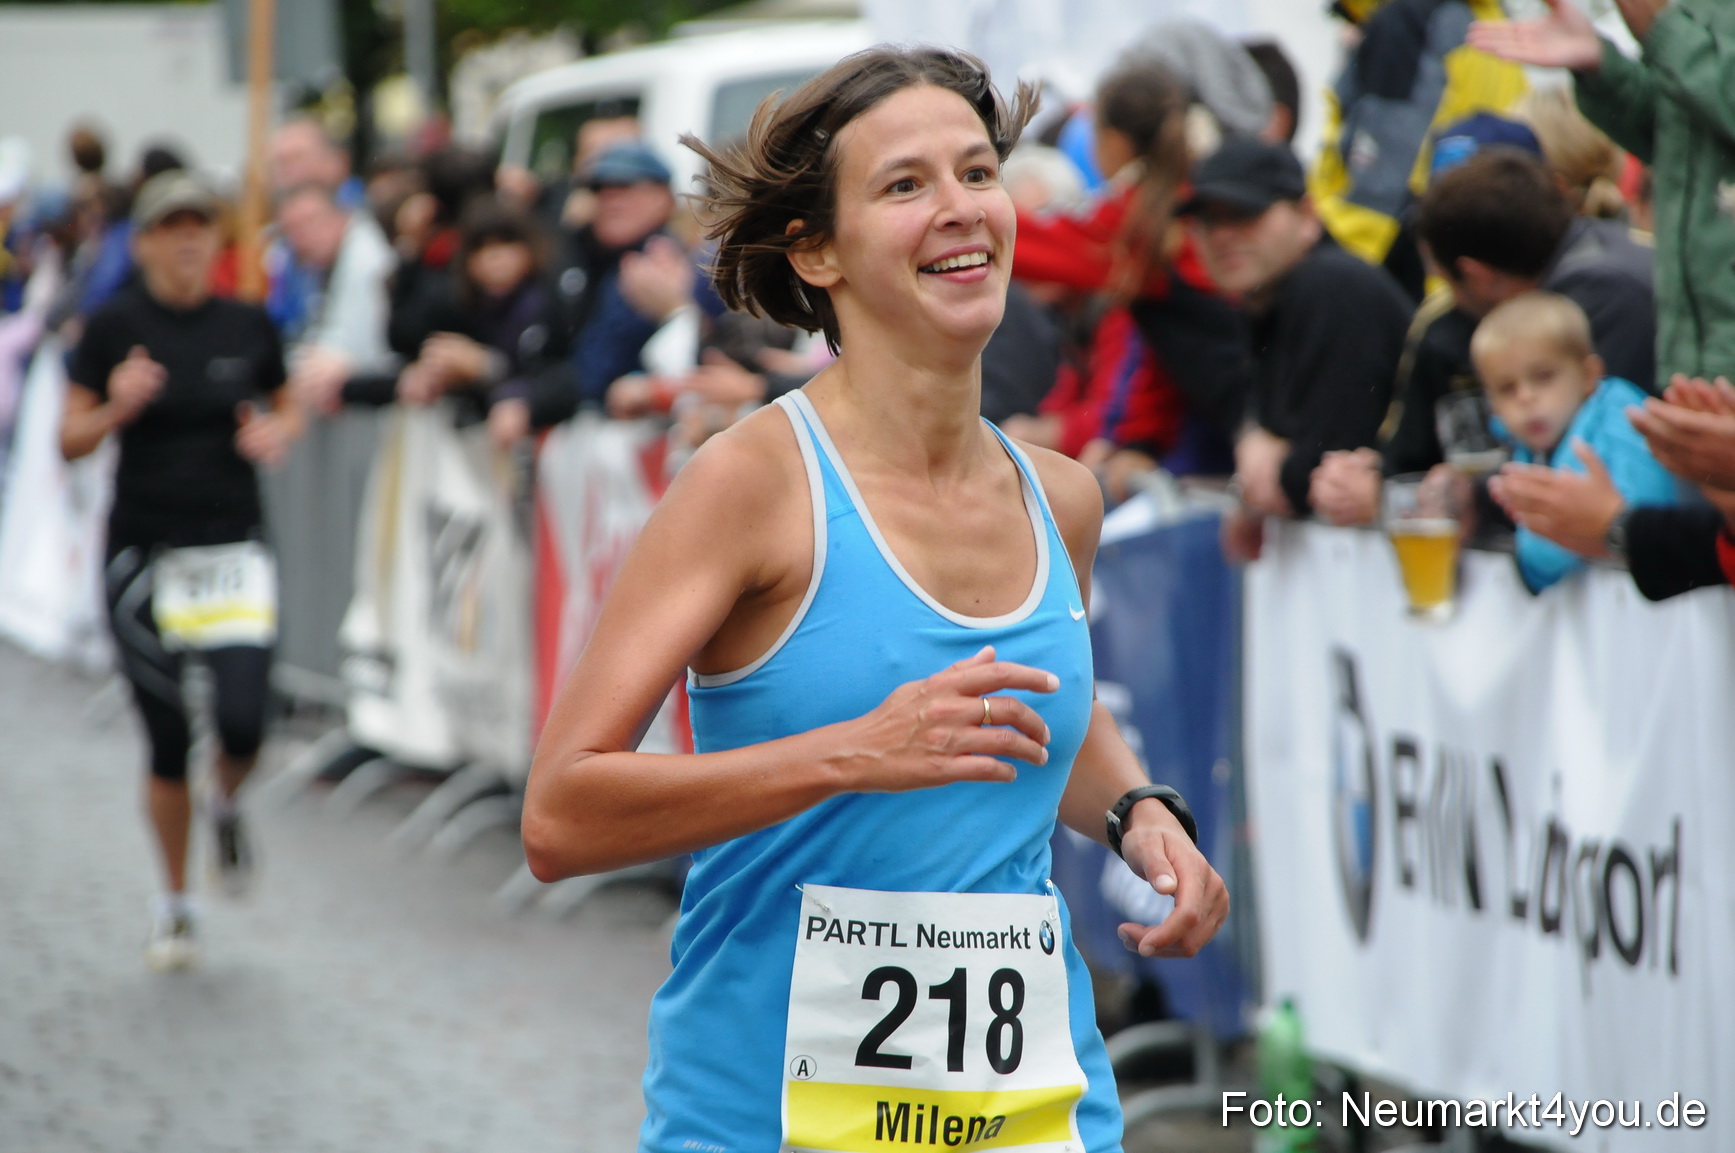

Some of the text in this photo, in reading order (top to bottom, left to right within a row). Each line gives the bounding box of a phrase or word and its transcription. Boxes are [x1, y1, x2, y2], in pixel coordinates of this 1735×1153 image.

[805, 915, 908, 948] PARTL
[916, 923, 1031, 950] Neumarkt
[855, 965, 1025, 1075] 218
[796, 1059, 809, 1077] A
[875, 1100, 1007, 1147] Milena
